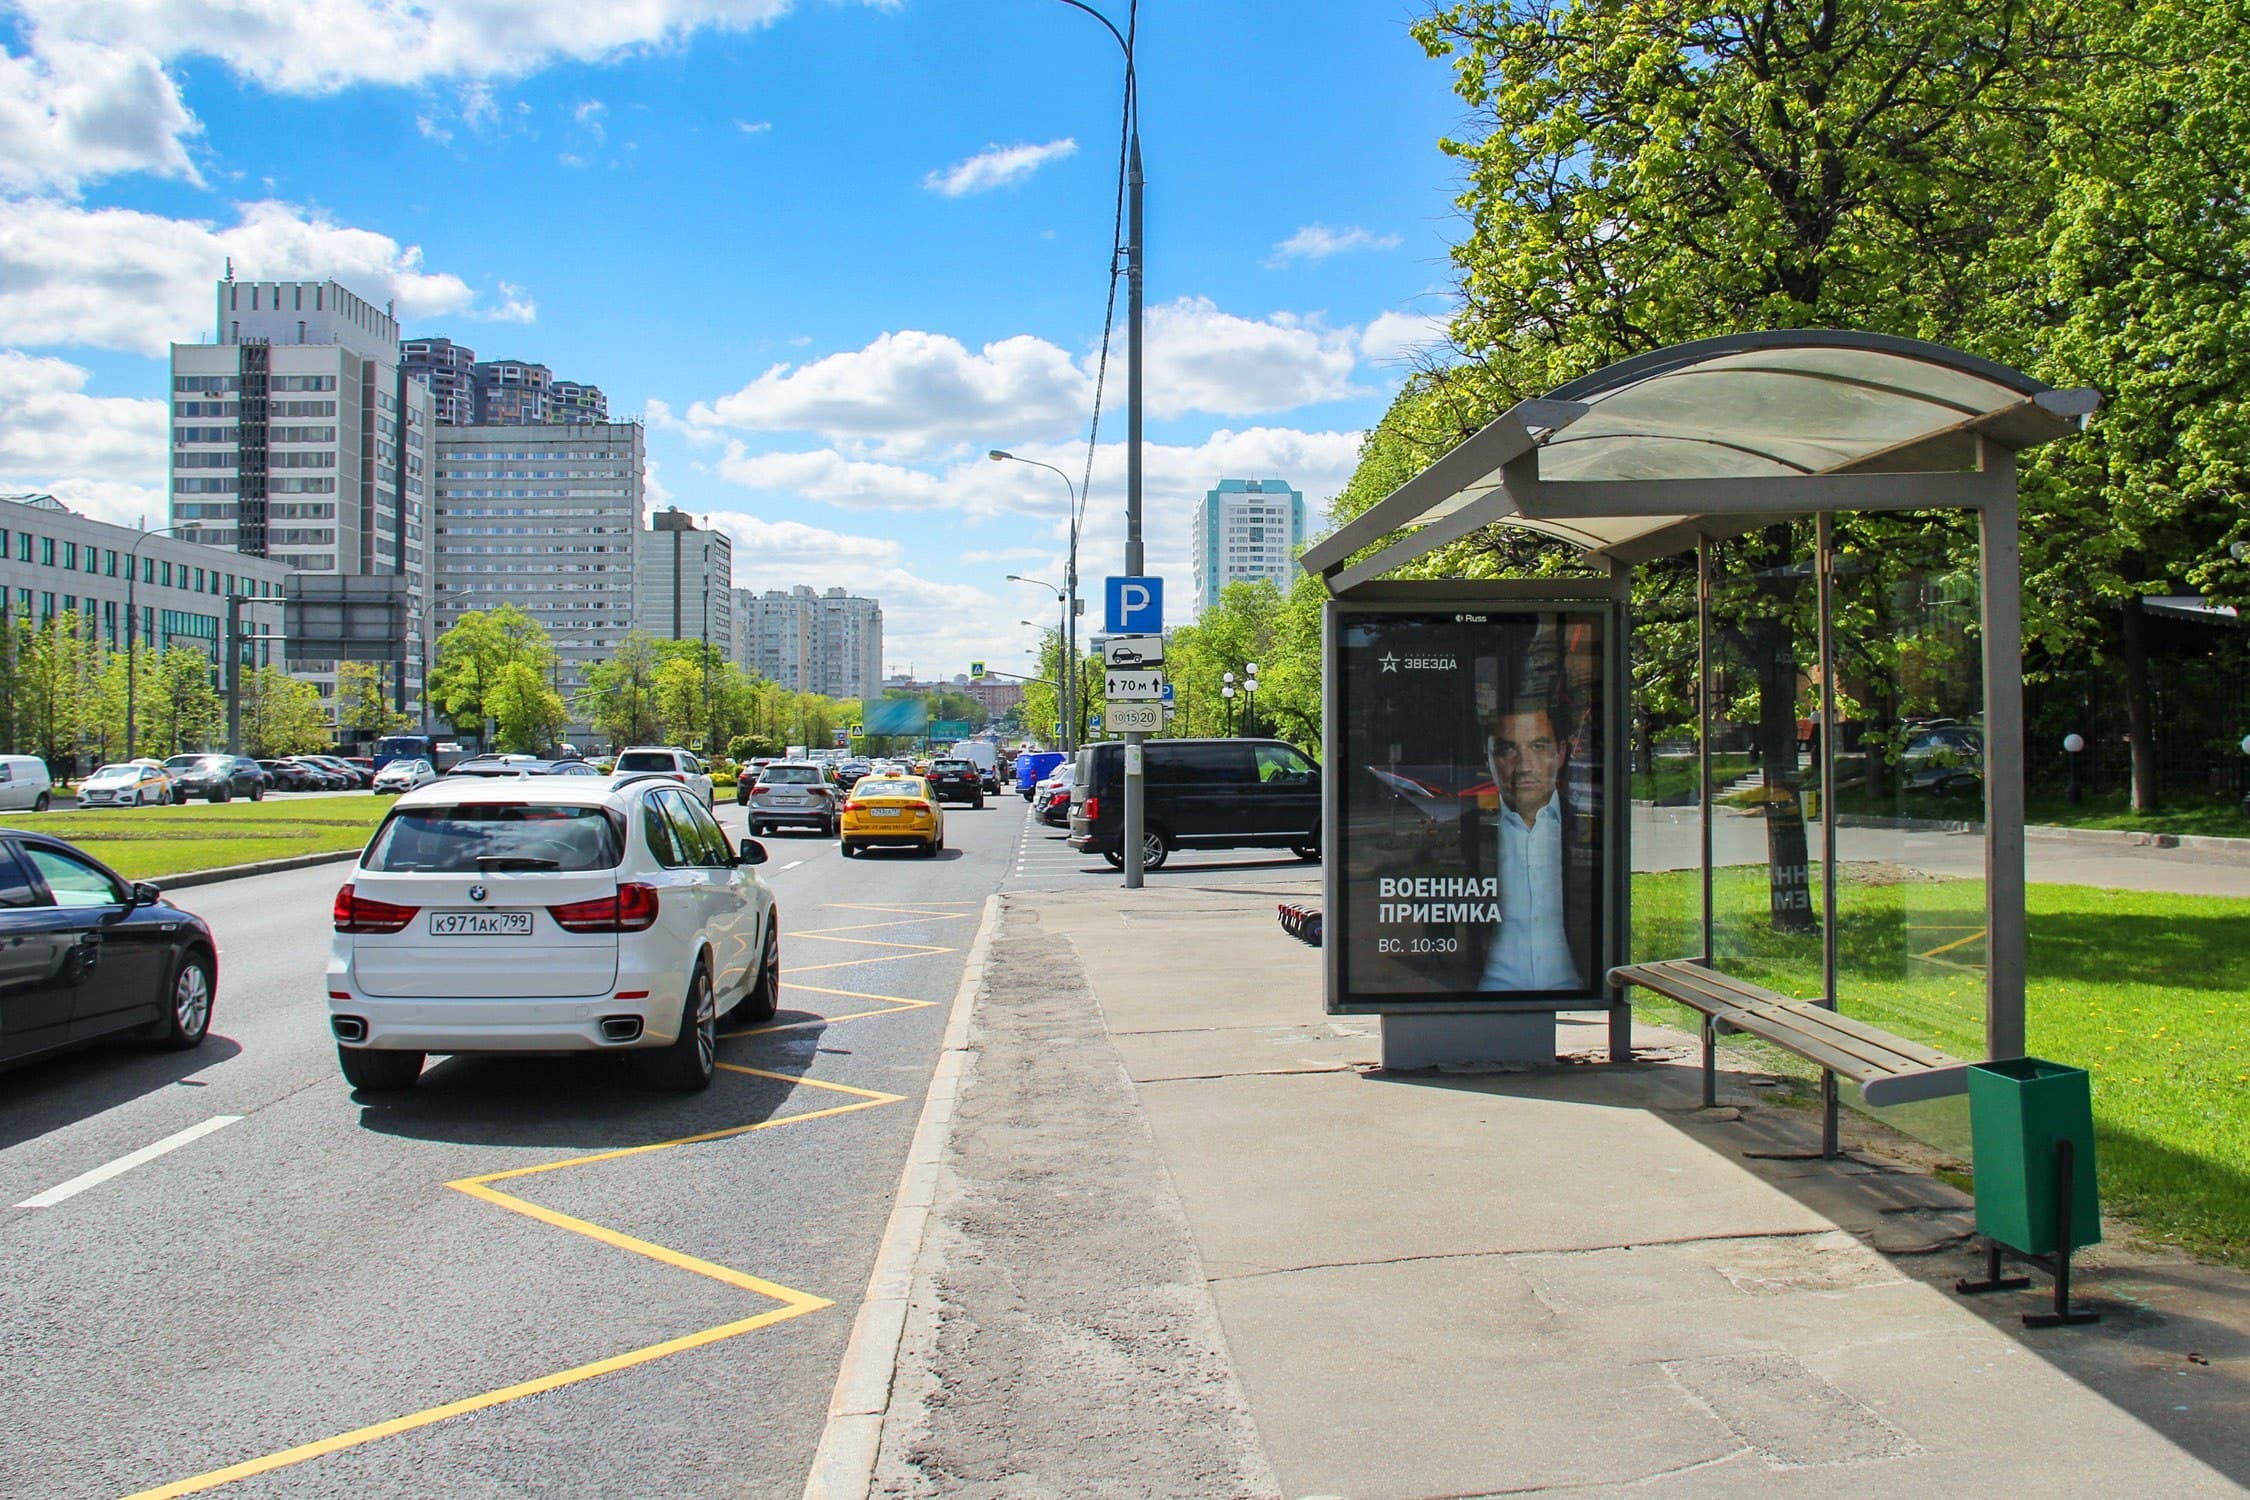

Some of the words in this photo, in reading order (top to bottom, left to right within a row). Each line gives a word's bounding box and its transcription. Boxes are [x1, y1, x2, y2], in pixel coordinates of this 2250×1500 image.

[1120, 584, 1150, 626] P
[1465, 614, 1487, 623] Russ
[1404, 658, 1457, 671] ЗВЕЗДА
[1120, 680, 1136, 691] 70
[1114, 714, 1124, 722] 10
[1126, 713, 1137, 722] 15
[1140, 712, 1154, 723] 20
[1379, 877, 1498, 898] ВОЕННАЯ
[1379, 903, 1502, 923] ПРИЕМКА
[1378, 938, 1404, 953] ВС.
[1410, 938, 1458, 953] 10:30
